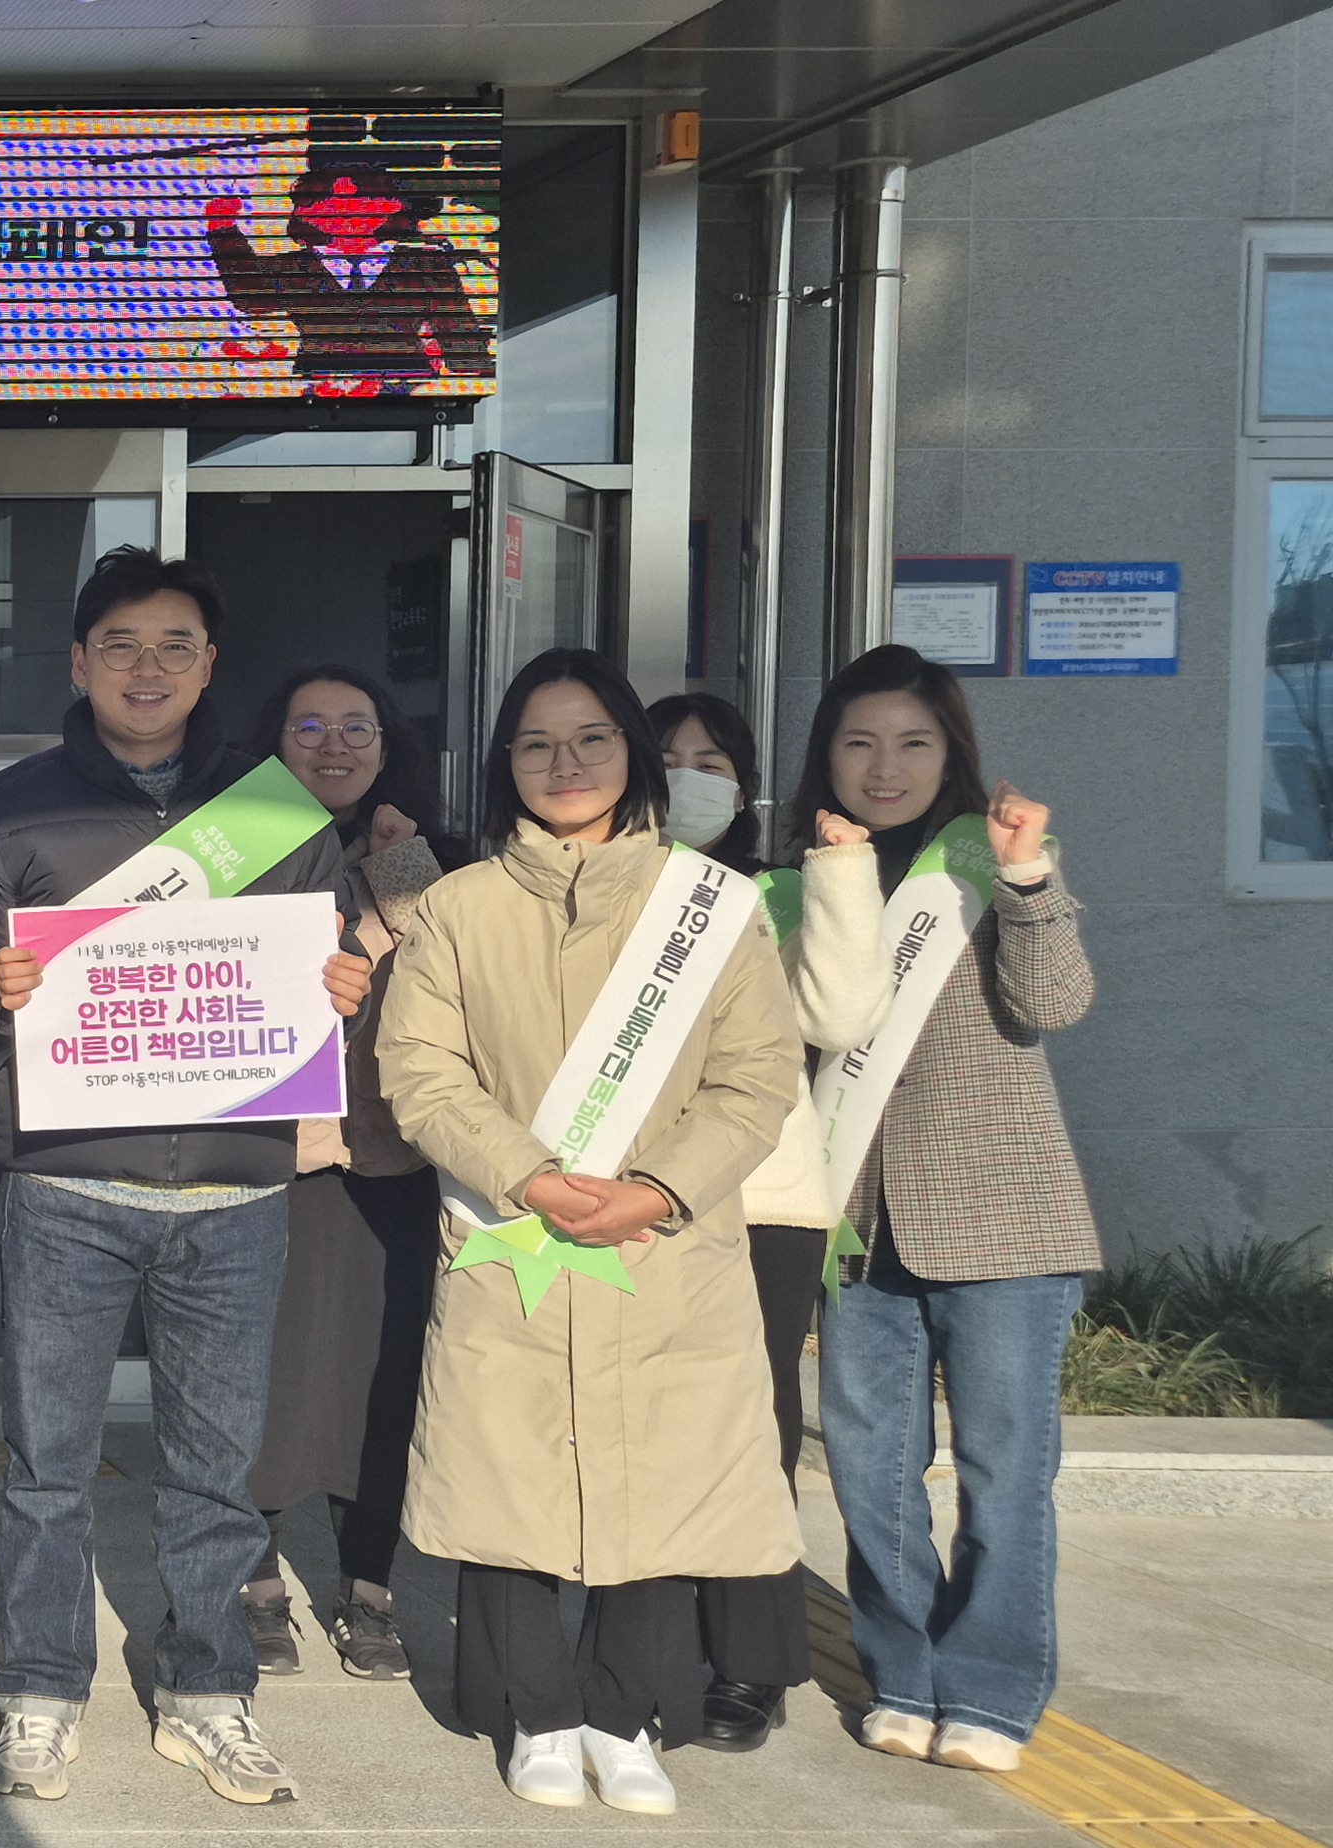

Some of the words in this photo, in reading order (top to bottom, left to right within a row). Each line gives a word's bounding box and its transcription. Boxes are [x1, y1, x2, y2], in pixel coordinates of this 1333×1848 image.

[191, 828, 238, 883] 아동학대
[206, 825, 246, 867] stop!
[690, 863, 727, 911] 11월
[77, 944, 105, 960] 11월
[109, 941, 149, 958] 19일은
[151, 937, 243, 955] 아동학대예방의
[246, 935, 260, 952] 날
[653, 905, 710, 984] 19일은
[86, 963, 177, 996] 행복한
[185, 959, 252, 991] 아이,
[78, 998, 168, 1030] 안전한
[176, 994, 265, 1026] 사회는
[51, 1033, 138, 1065] 어른의
[147, 1026, 298, 1061] 책임입니다
[86, 1074, 118, 1088] STOP
[121, 1071, 175, 1089] 아동학대
[177, 1070, 211, 1083] LOVE
[213, 1067, 276, 1081] CHILDREN
[565, 983, 667, 1155] 아동학대예방의
